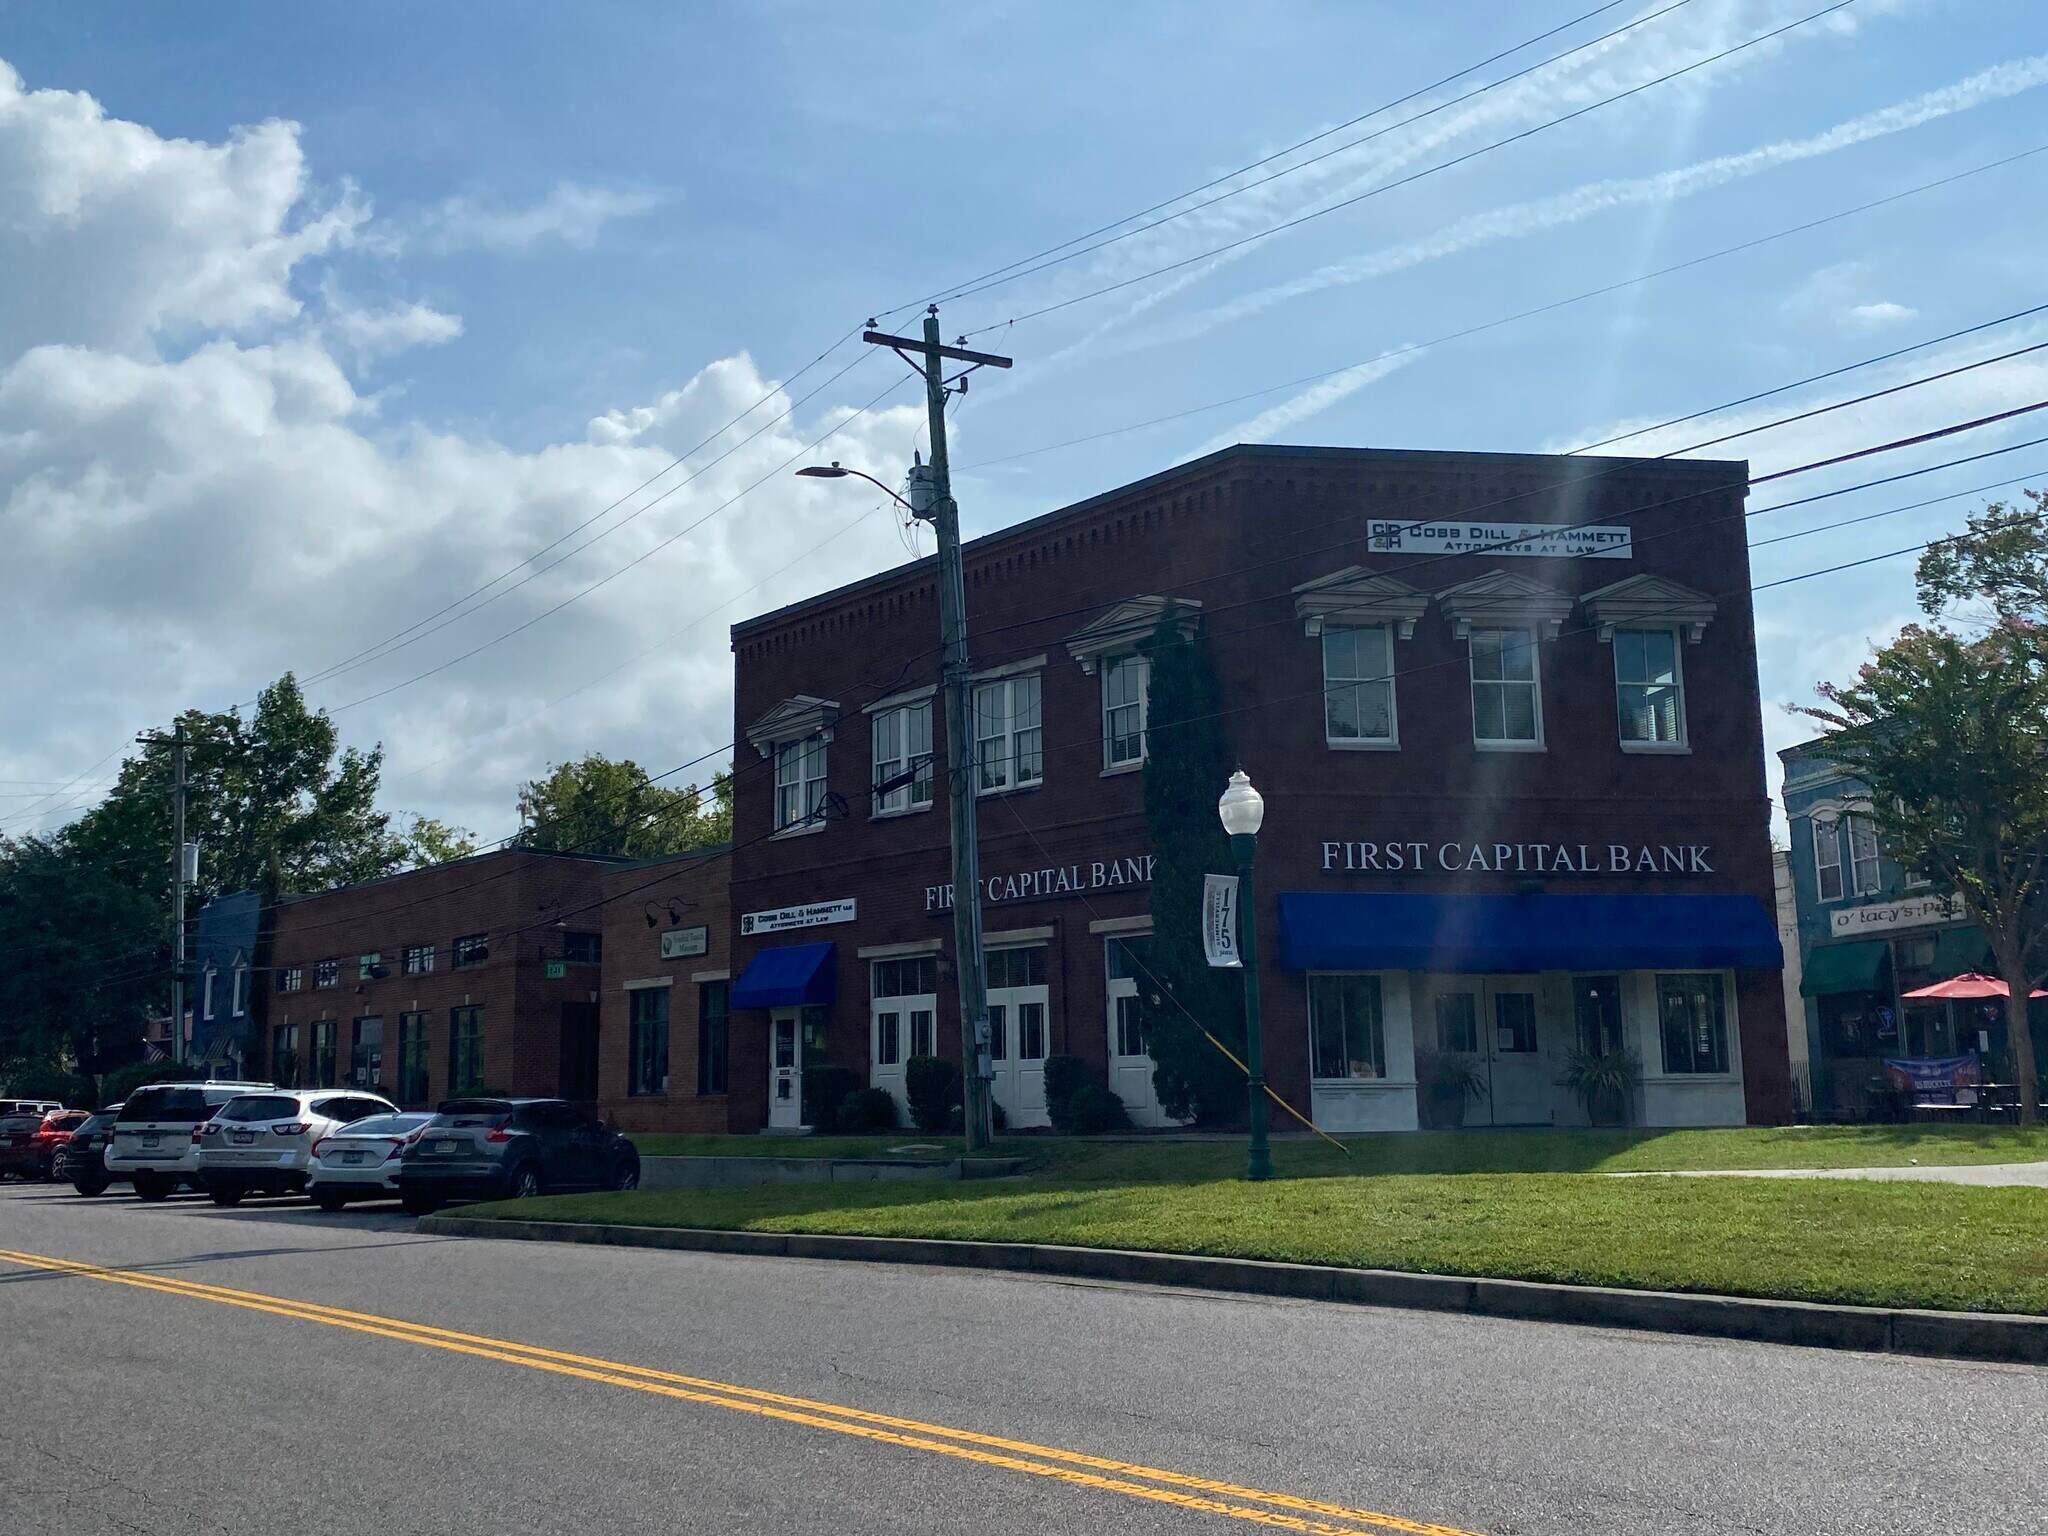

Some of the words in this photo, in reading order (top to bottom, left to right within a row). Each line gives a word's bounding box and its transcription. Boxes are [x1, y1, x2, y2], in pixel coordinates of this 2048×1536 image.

[1410, 527, 1460, 538] COBB
[1470, 528, 1511, 540] DILL
[1518, 529, 1531, 540] &
[1541, 529, 1627, 543] HAMMETT
[1540, 545, 1557, 553] AT
[1566, 545, 1596, 554] LAW
[1321, 842, 1430, 870] FIRST
[1438, 843, 1601, 872] CAPITAL
[1608, 844, 1716, 873] BANK
[924, 879, 984, 910] FIR
[988, 865, 1087, 901] CAPITAL
[757, 914, 778, 923] COBB
[780, 912, 796, 920] DILL
[806, 905, 842, 915] HAMMETT
[769, 919, 803, 929] ATTORNEYS
